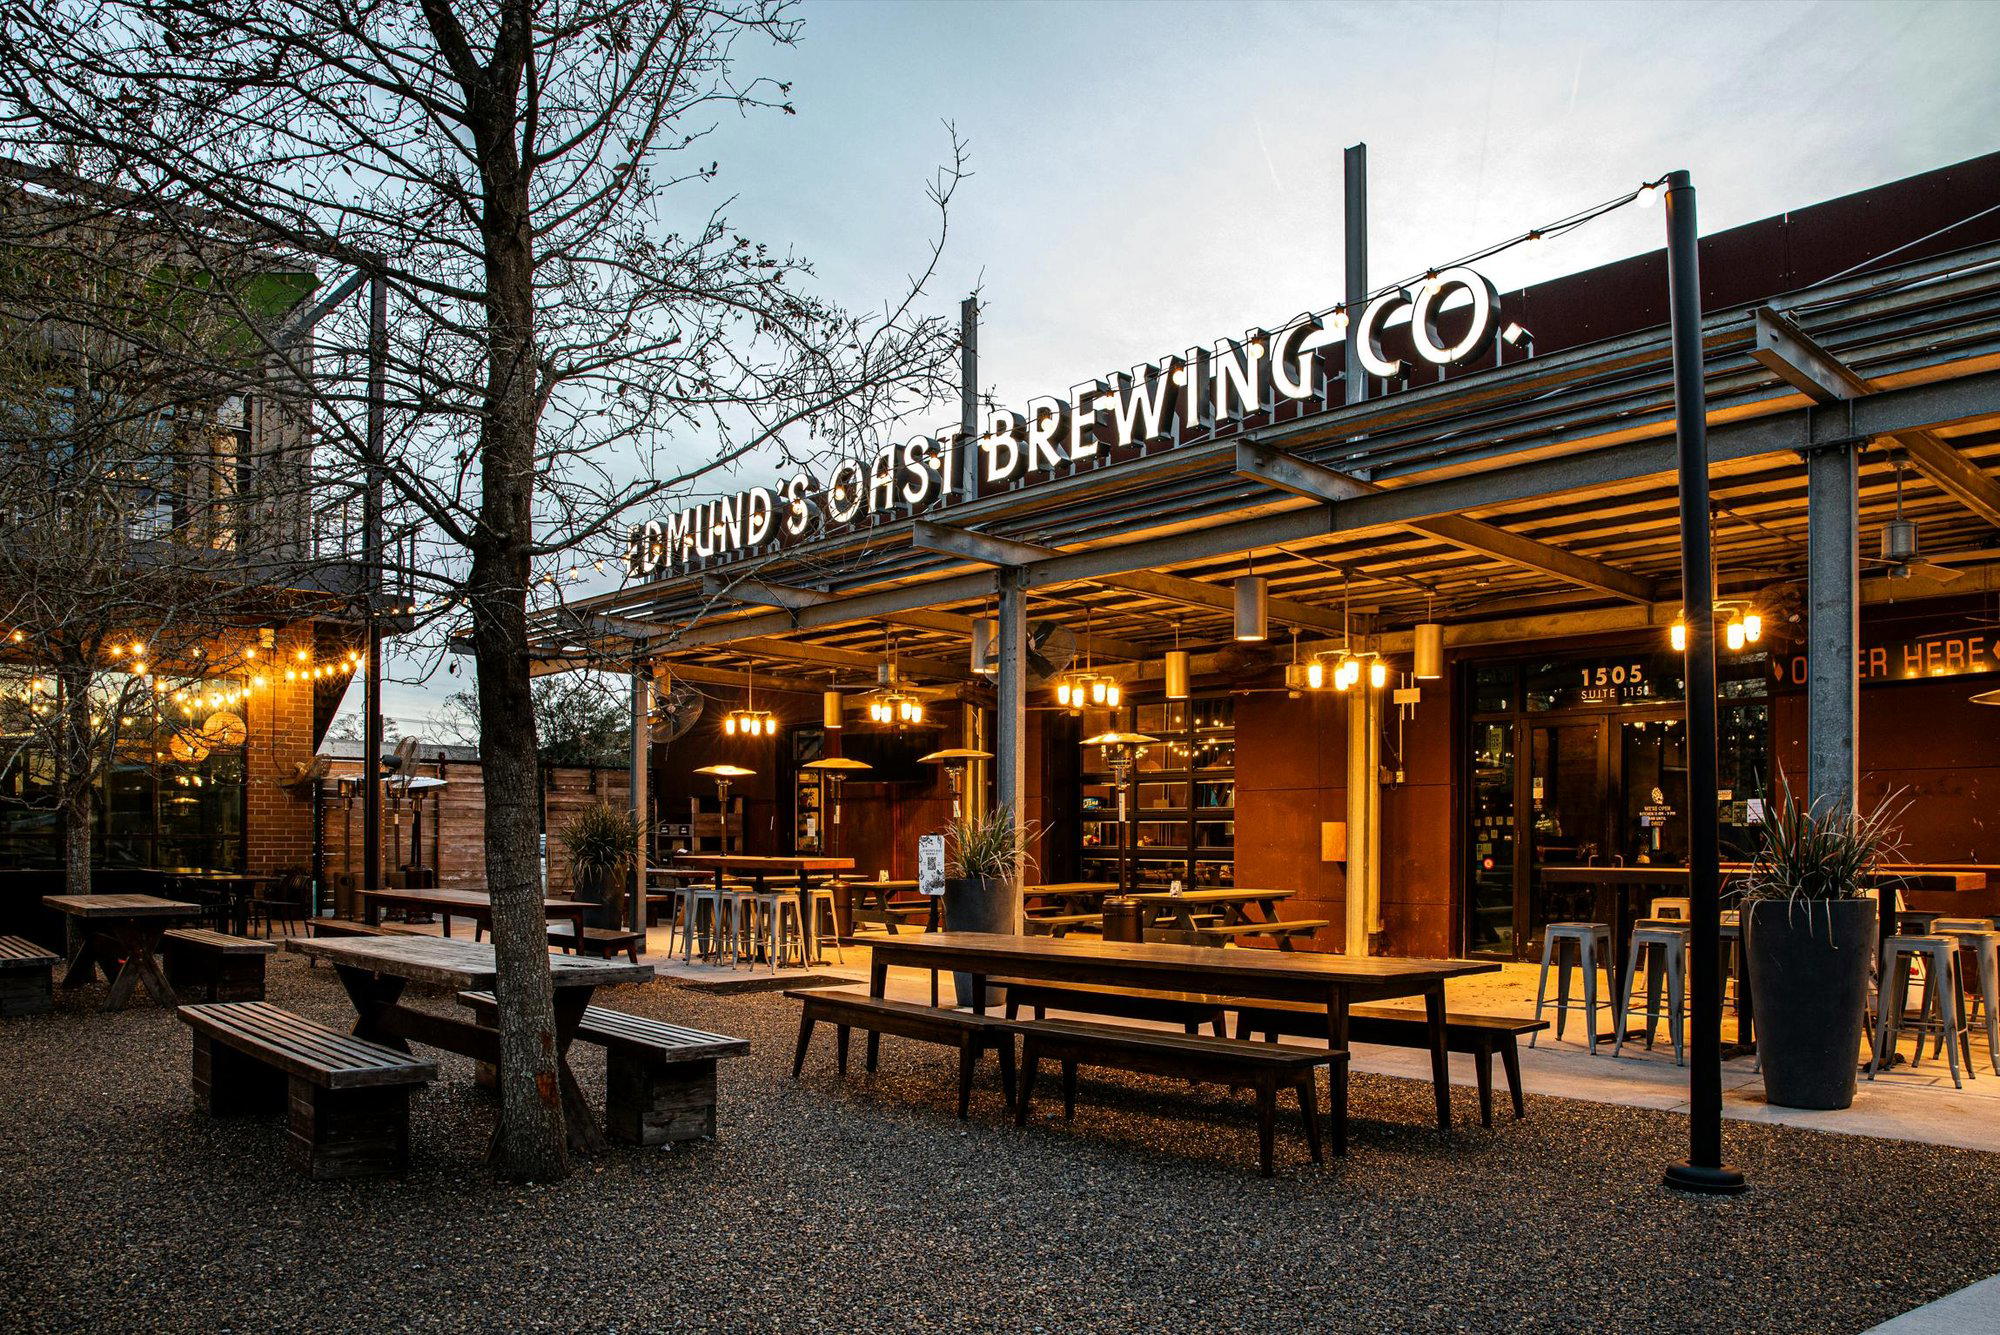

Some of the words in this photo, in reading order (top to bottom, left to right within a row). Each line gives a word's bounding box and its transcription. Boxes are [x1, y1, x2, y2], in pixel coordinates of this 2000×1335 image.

[827, 424, 963, 523] OAST
[986, 312, 1326, 482] BREWING
[1356, 266, 1532, 377] CO.
[1581, 664, 1643, 687] 1505
[1791, 647, 1887, 684] OER
[1903, 637, 1984, 676] HERE
[1581, 688, 1616, 700] SUITE
